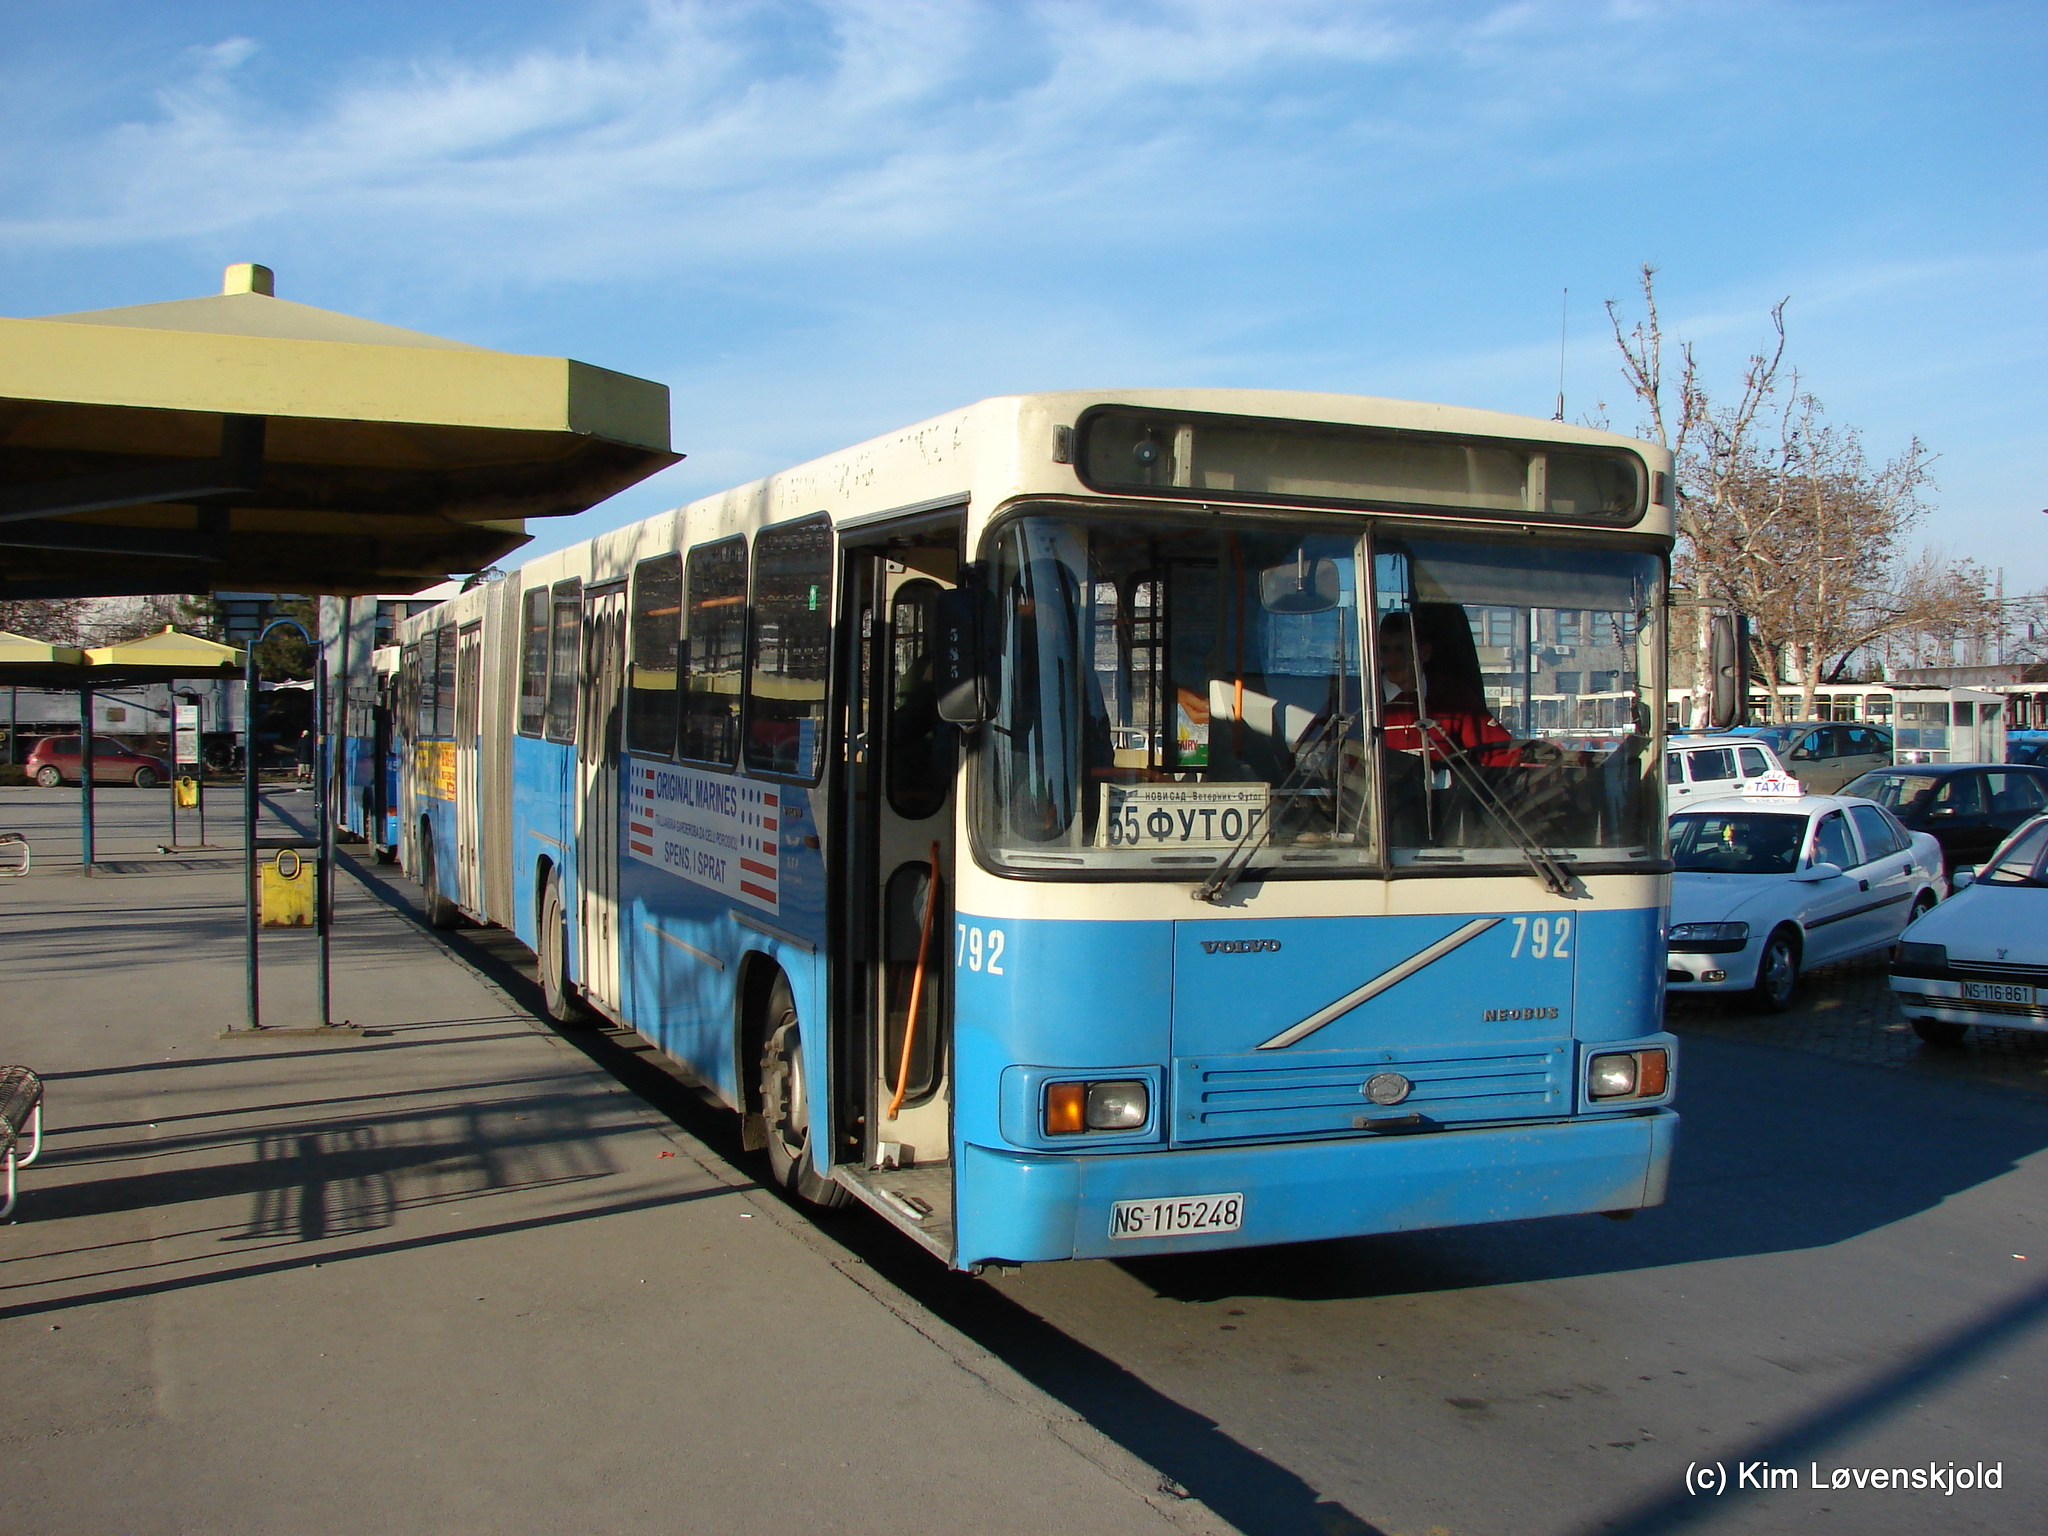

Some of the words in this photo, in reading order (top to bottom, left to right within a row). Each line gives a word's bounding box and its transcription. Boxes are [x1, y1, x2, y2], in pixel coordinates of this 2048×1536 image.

[656, 771, 694, 807] ORIGINAL
[695, 779, 737, 818] MARINES
[1755, 782, 1786, 792] TAXI
[1109, 806, 1140, 846] 55
[1146, 807, 1262, 843] ФУТОГ
[697, 851, 727, 885] SPRAT
[957, 923, 1005, 976] 792
[1199, 938, 1282, 955] VOLVO
[1510, 916, 1571, 959] 792
[1483, 1005, 1559, 1022] NEOBUS
